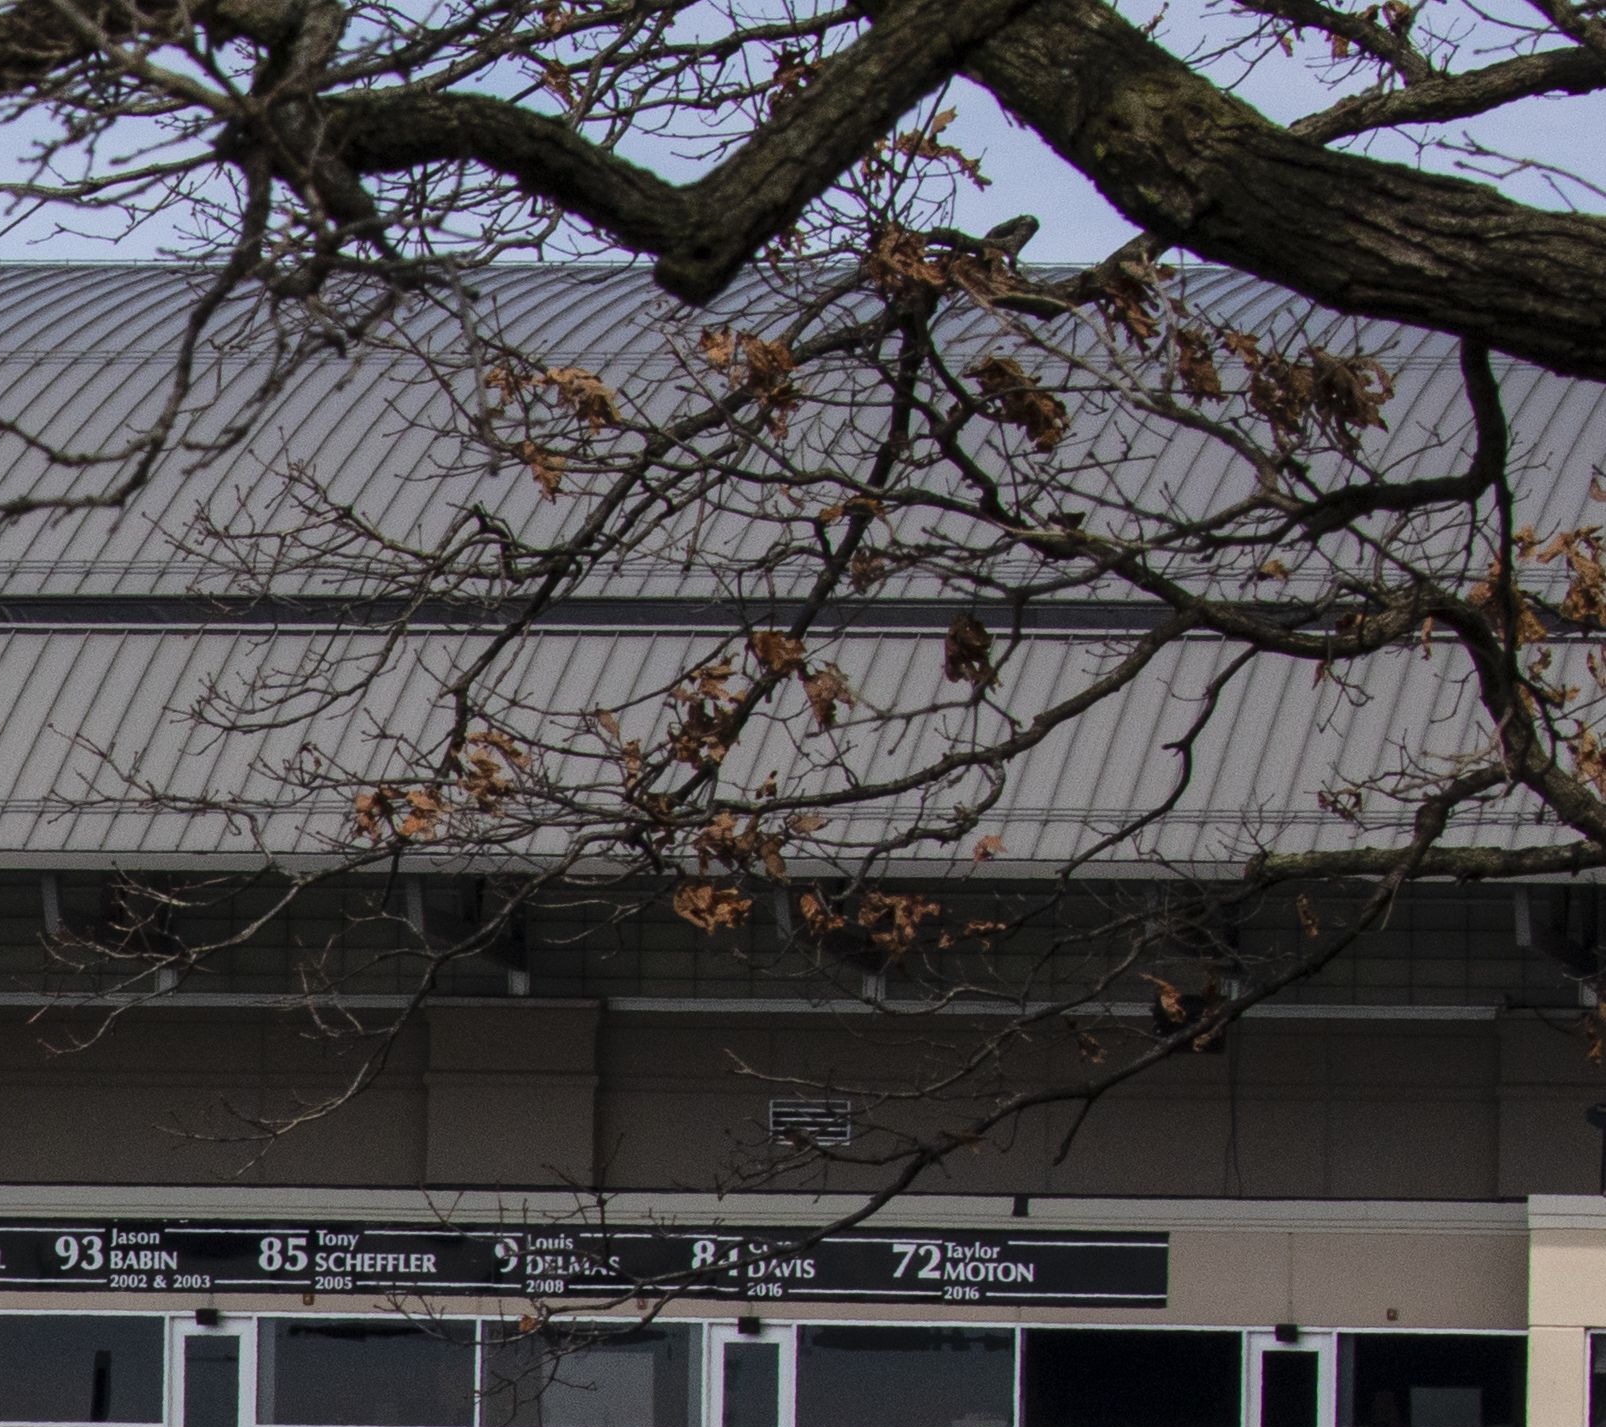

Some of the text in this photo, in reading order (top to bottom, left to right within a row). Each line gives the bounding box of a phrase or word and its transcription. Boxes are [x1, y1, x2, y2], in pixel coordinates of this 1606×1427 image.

[111, 1228, 160, 1246] Jason
[316, 1230, 359, 1250] Tony
[56, 1236, 103, 1270] 93
[110, 1251, 177, 1270] BABIN
[259, 1238, 308, 1270] 85
[316, 1252, 436, 1272] SCHEFFLER
[893, 1244, 940, 1278] 72
[944, 1242, 1000, 1262] Taylor
[944, 1262, 1033, 1282] MOTON
